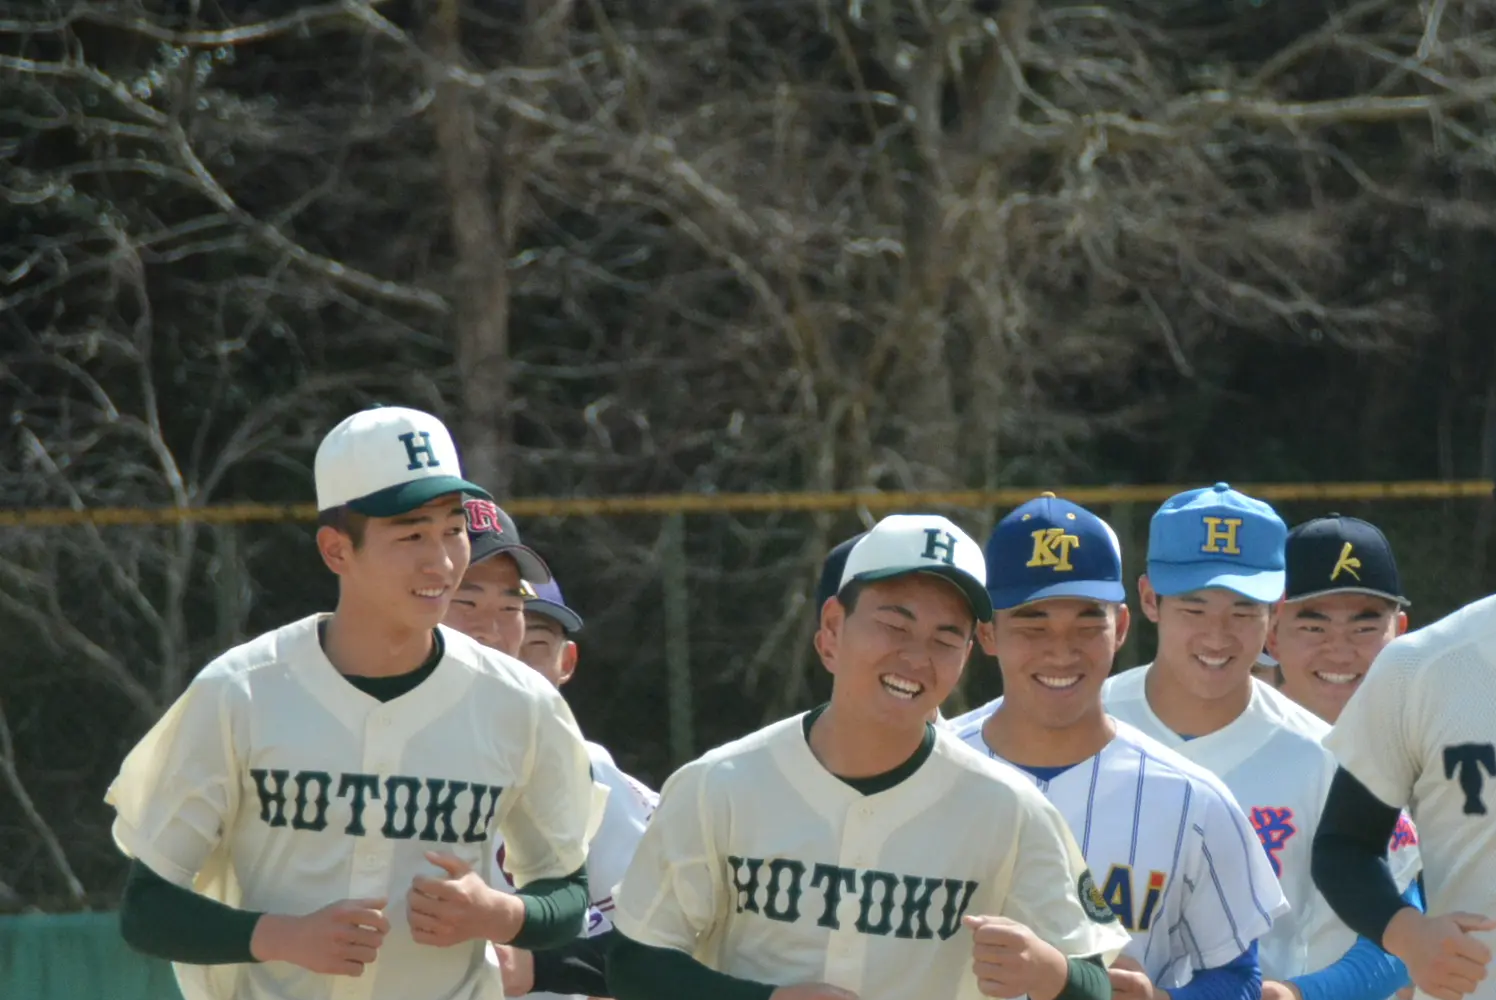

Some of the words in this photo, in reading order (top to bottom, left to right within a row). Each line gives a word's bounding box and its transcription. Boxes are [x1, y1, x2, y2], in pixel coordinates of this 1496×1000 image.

[398, 431, 440, 470] H
[921, 528, 957, 565] H
[1026, 528, 1080, 571] KT
[1202, 517, 1243, 554] H
[250, 768, 503, 843] HOTOKU
[728, 856, 978, 941] HOTOKU
